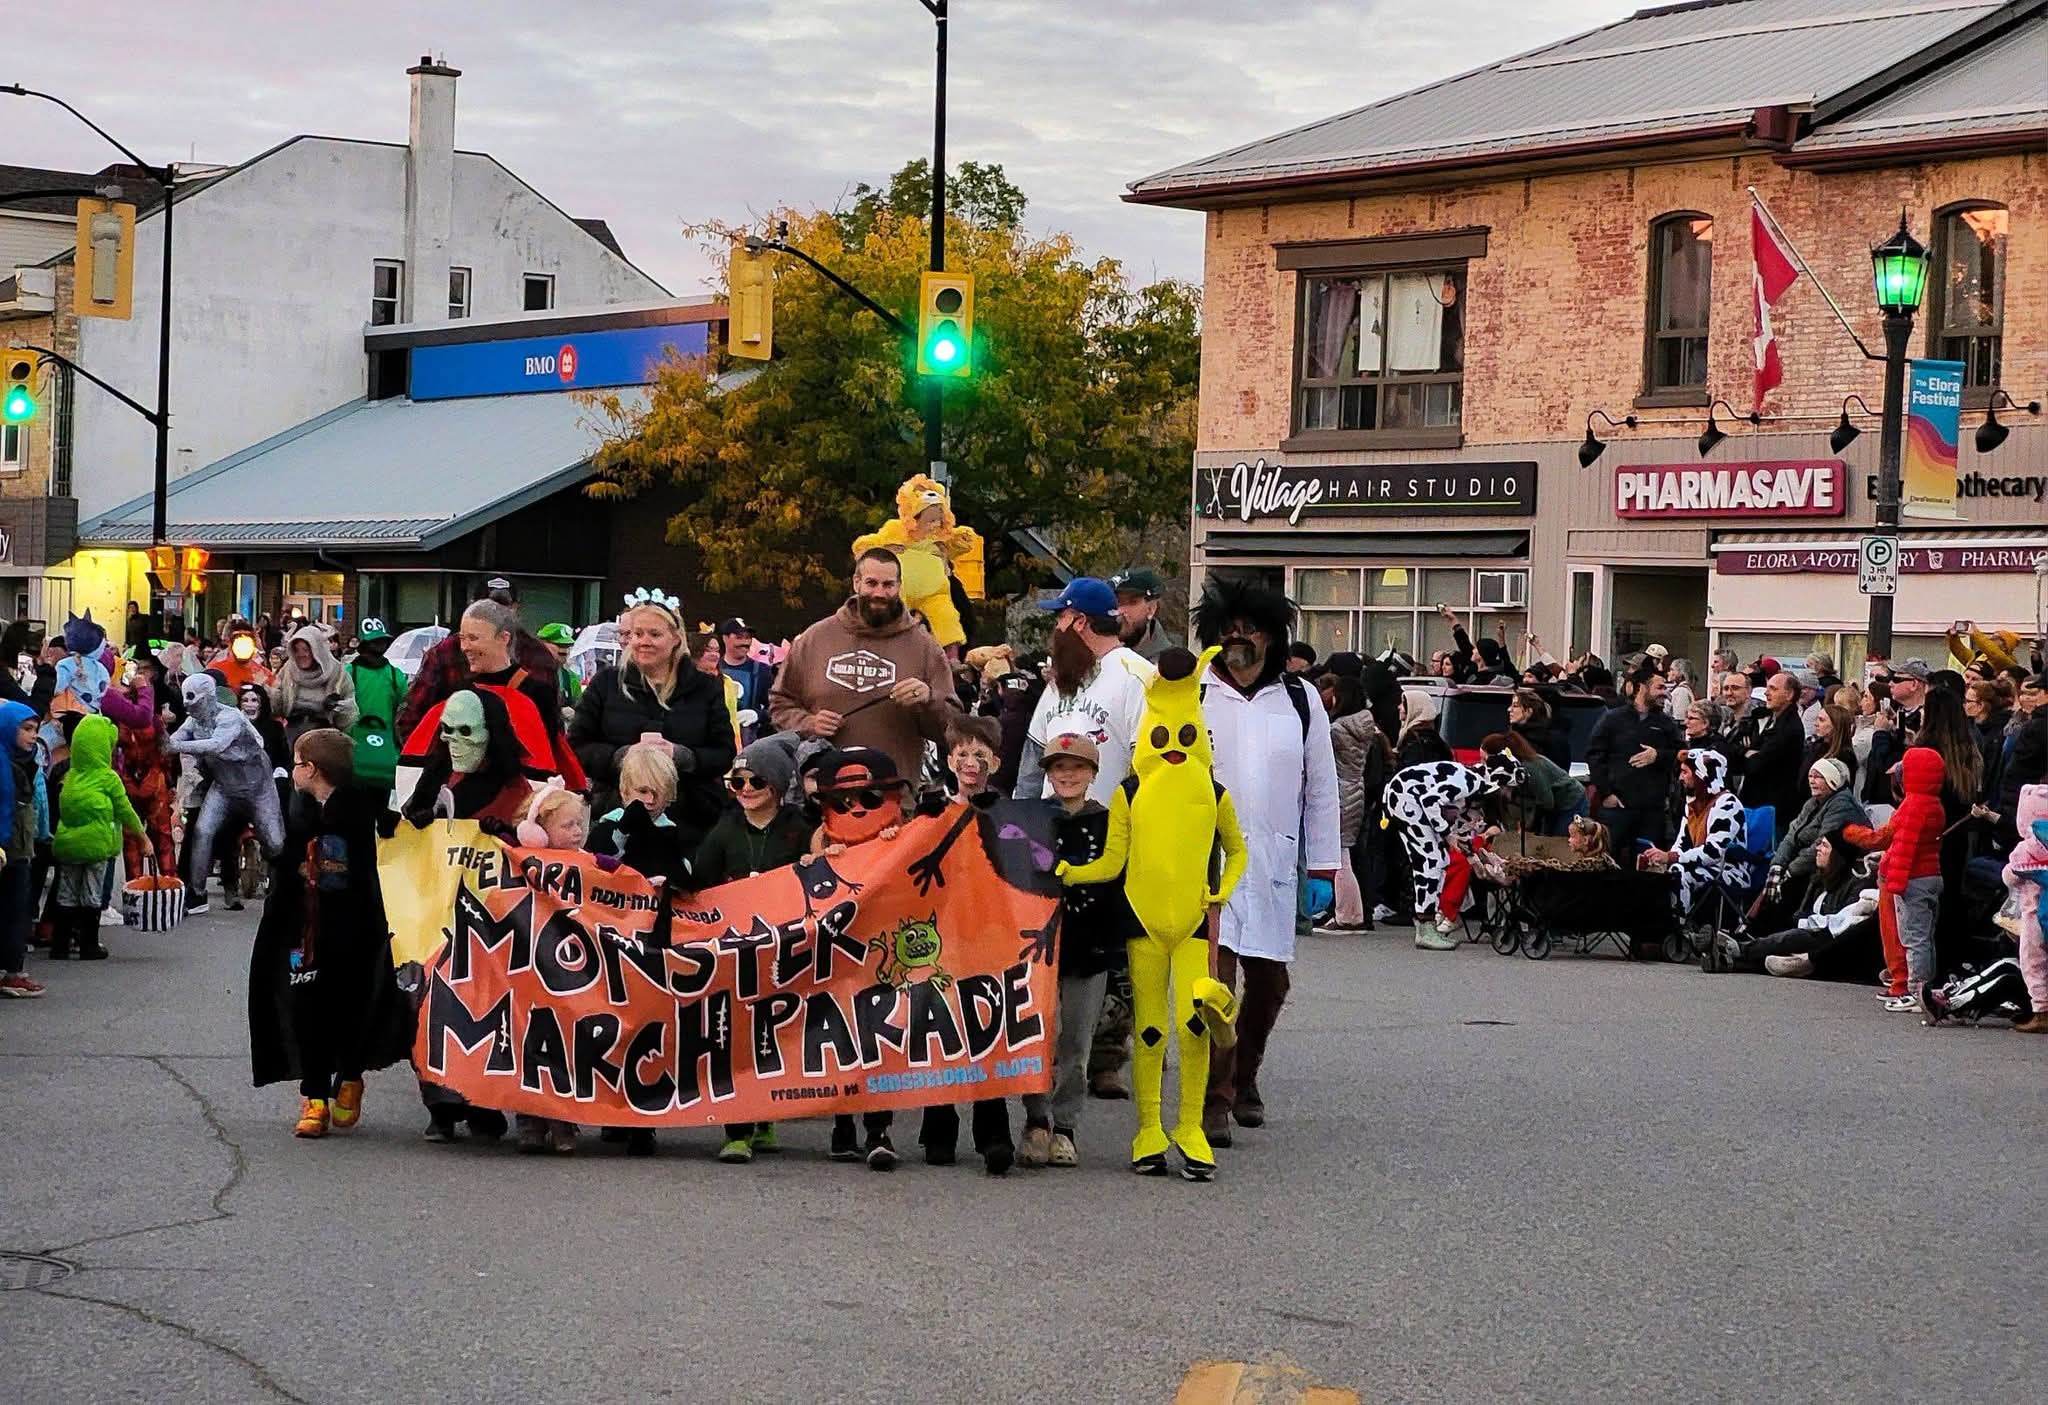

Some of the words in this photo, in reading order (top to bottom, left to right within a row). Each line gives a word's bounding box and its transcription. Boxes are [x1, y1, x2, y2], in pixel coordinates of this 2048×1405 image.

[525, 356, 555, 375] BMO
[1928, 377, 1960, 393] Elora
[1912, 390, 1960, 407] Festival
[1230, 459, 1323, 525] Village
[1329, 479, 1391, 498] HAIR
[1408, 477, 1517, 497] STUDIO
[1617, 468, 1834, 511] PHARMASAVE
[1746, 553, 1797, 568] ELORA
[1960, 550, 2040, 567] PHARMA
[1874, 546, 1886, 559] P
[1870, 566, 1875, 574] 3
[1877, 566, 1887, 574] HR
[1079, 697, 1109, 724] JAYS
[447, 847, 486, 869] THE
[478, 849, 582, 905] ELORA
[450, 880, 869, 1006] MONSTER
[289, 970, 317, 986] EAST
[427, 970, 733, 1115] MARCH
[748, 961, 1044, 1079] PARADE
